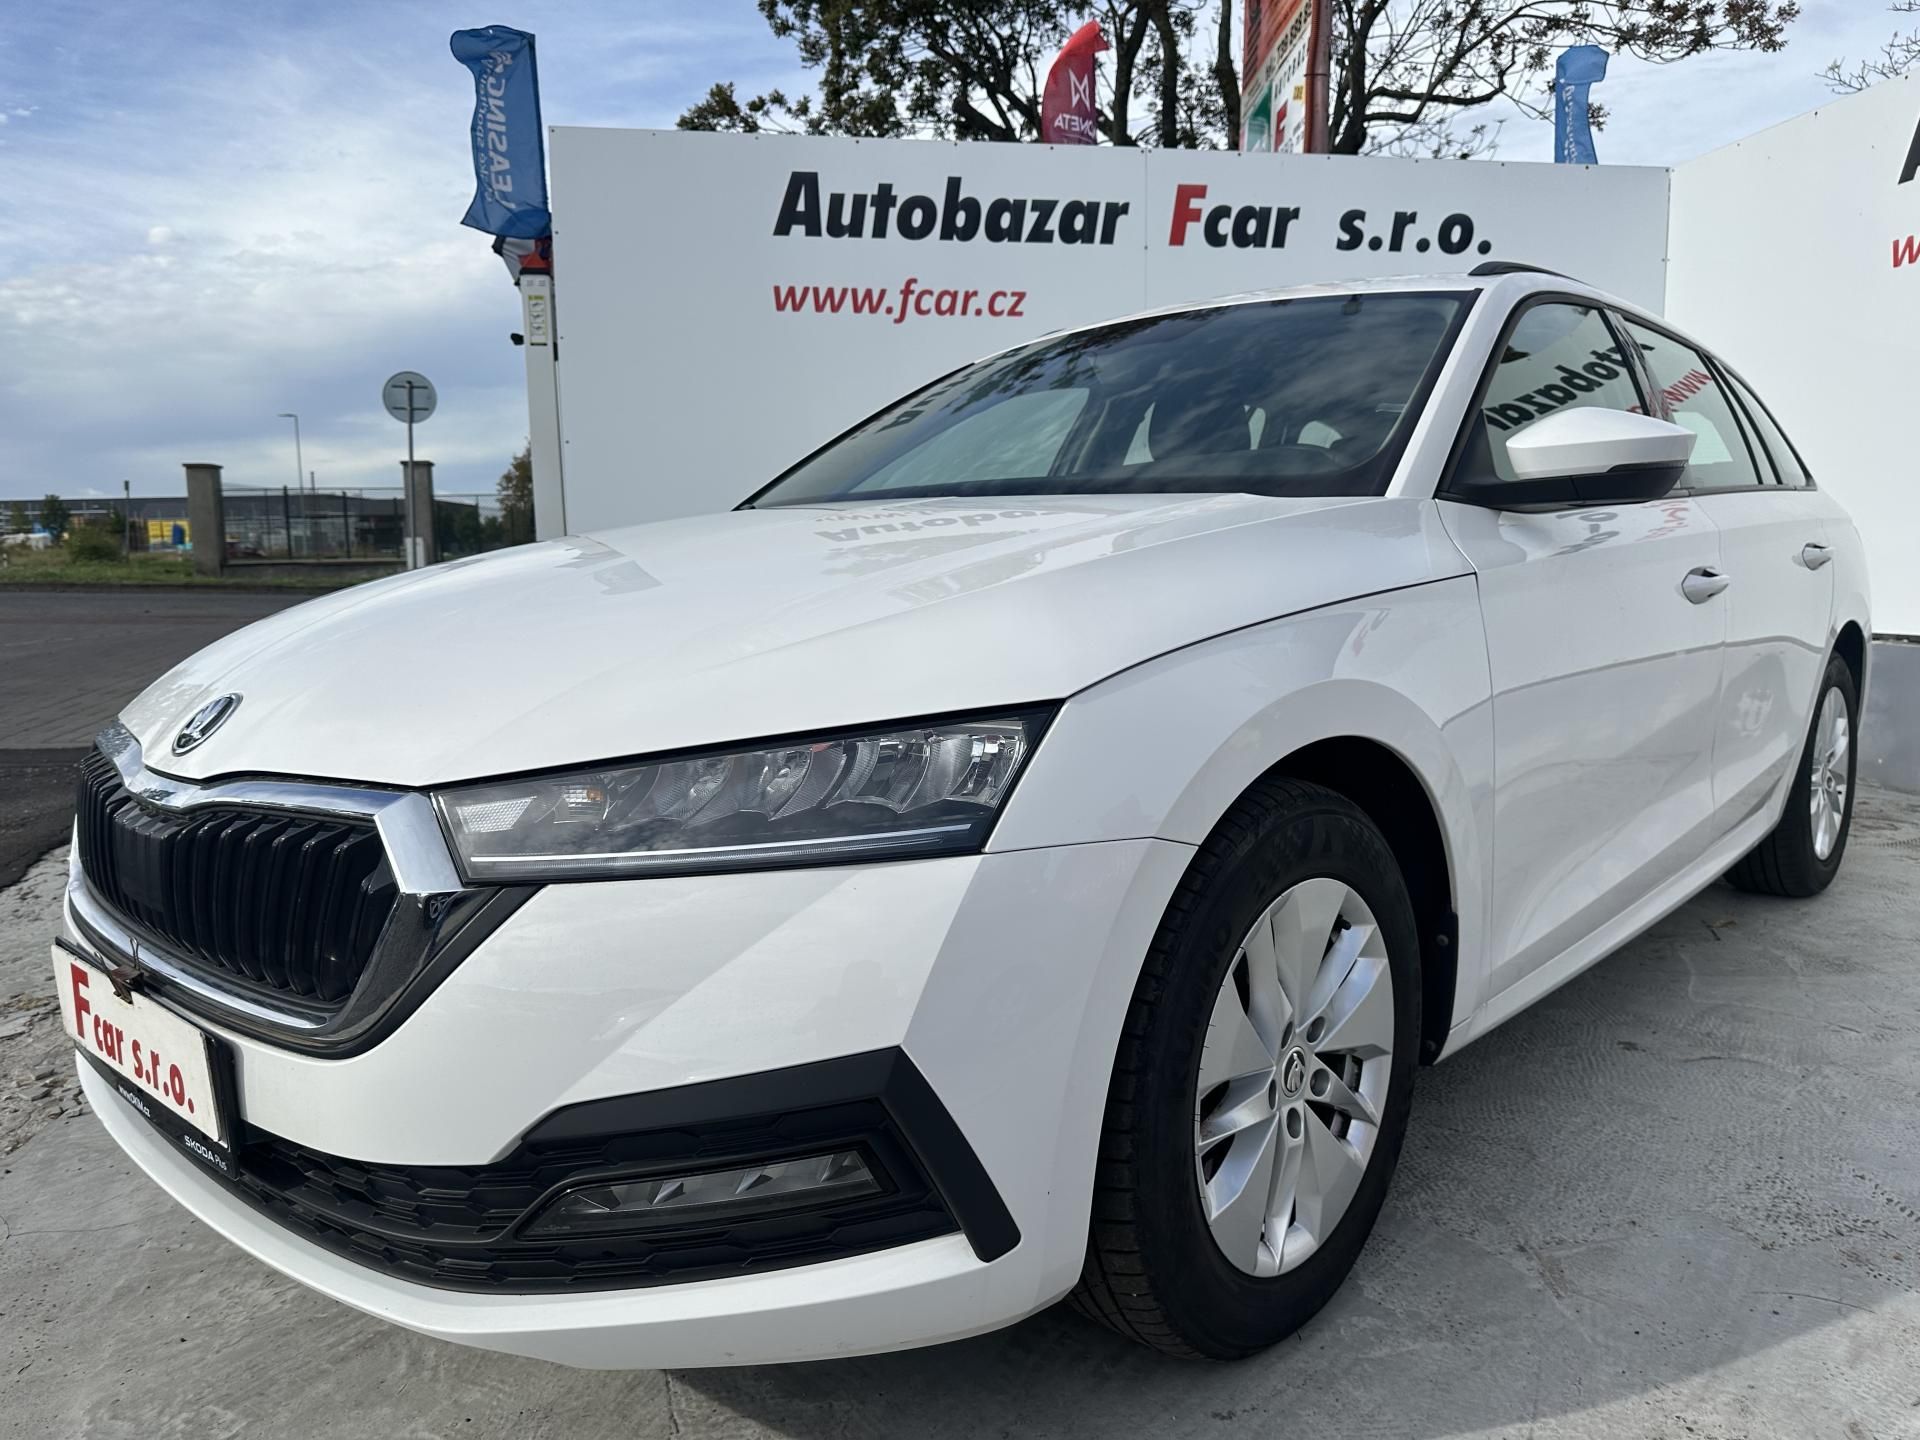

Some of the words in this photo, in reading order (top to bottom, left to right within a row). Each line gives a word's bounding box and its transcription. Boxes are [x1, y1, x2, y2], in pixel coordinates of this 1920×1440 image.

[773, 171, 1130, 245] Autobazar
[1168, 184, 1300, 249] Fcar
[1336, 209, 1492, 255] s.r.o.
[773, 278, 1027, 324] www.fcar.cz
[70, 962, 91, 1039] F
[93, 1014, 124, 1066] car
[131, 1039, 194, 1114] s.r.o.
